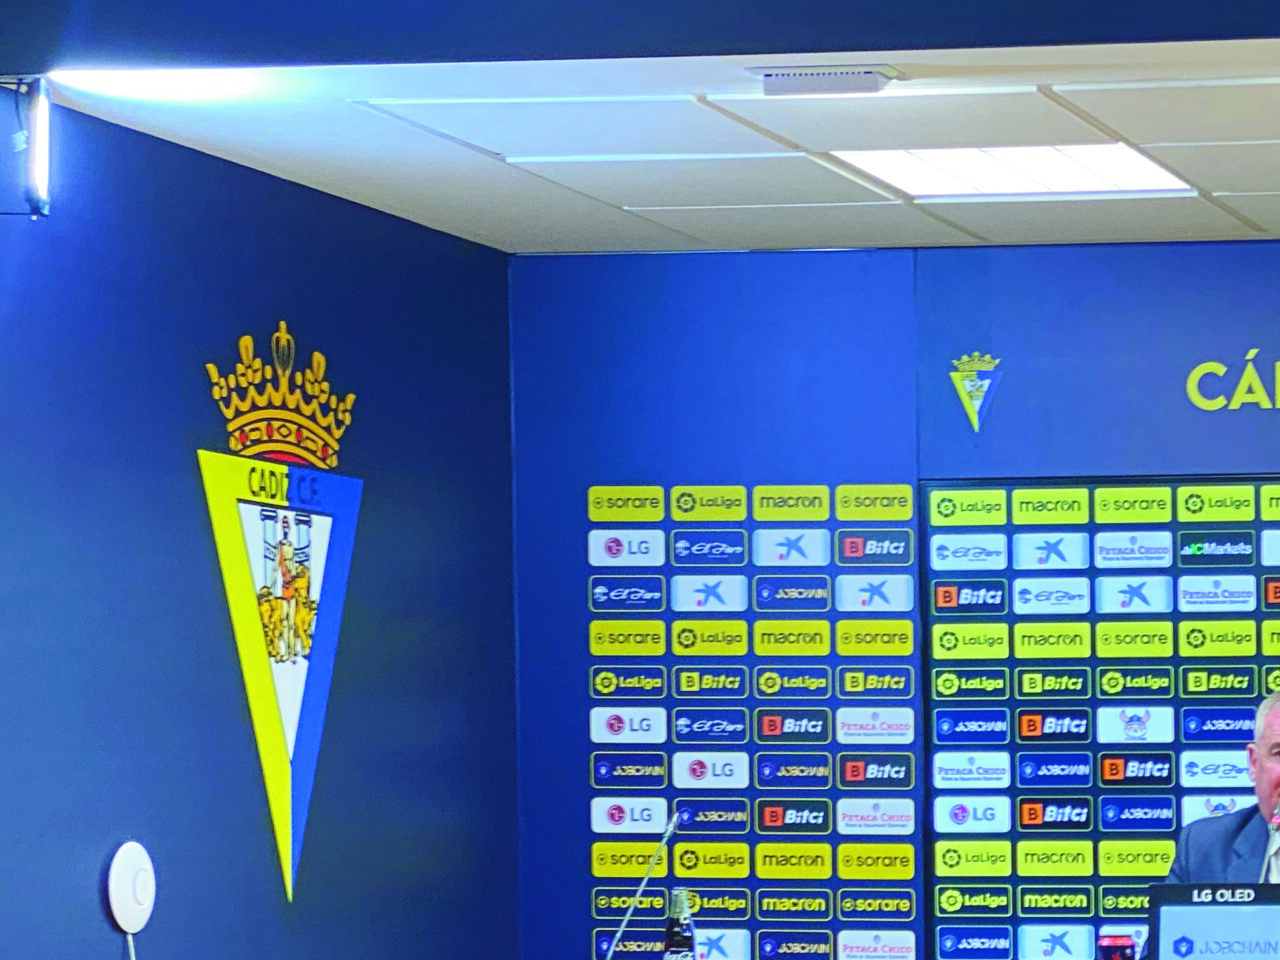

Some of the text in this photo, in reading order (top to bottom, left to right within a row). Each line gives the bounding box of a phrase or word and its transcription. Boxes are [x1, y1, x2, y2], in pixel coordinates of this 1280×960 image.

[606, 496, 659, 508] sorare
[699, 496, 741, 509] LaLiga
[760, 496, 822, 508] macron
[854, 495, 908, 508] sorare
[959, 500, 1002, 514] LaLiga
[1019, 499, 1081, 512] macron
[1113, 497, 1167, 510] sorare
[1206, 496, 1250, 509] LaLiga
[627, 539, 650, 554] LG
[864, 540, 906, 555] Bitci
[958, 587, 1003, 604] Bitci
[608, 630, 660, 643] sorare
[700, 630, 743, 644] LaLiga
[761, 631, 823, 643] macron
[855, 630, 909, 643] sorare
[961, 634, 1003, 647] LaLiga
[1021, 633, 1083, 646] macron
[1115, 632, 1168, 644] sorare
[1208, 631, 1251, 644] LaLiga
[700, 674, 741, 689] Bitci
[960, 676, 1004, 691] LaLiga
[1042, 675, 1084, 689] Bitci
[1124, 675, 1169, 689] LaLiga
[1207, 673, 1249, 688] Bitci
[629, 717, 652, 732] LG
[783, 718, 823, 733] Bitci
[1042, 716, 1086, 732] Bitci
[712, 762, 735, 777] LG
[865, 763, 907, 778] Bitci
[1124, 759, 1169, 776] Bitci
[630, 807, 653, 821] LG
[783, 808, 824, 823] Bitci
[974, 806, 996, 821] LG
[1043, 804, 1088, 821] Bitci
[702, 853, 745, 866] LaLiga
[763, 854, 825, 866] macron
[856, 854, 910, 866] sorare
[964, 851, 1006, 864] LaLiga
[1024, 851, 1086, 864] macron
[1117, 850, 1170, 863] sorare
[963, 894, 1007, 908] LaLiga
[1023, 894, 1087, 907] macron
[1192, 888, 1255, 902] LG OLED
[762, 897, 826, 910] macron
[856, 897, 910, 910] sorare
[1199, 940, 1279, 956] JOBCHAIN
